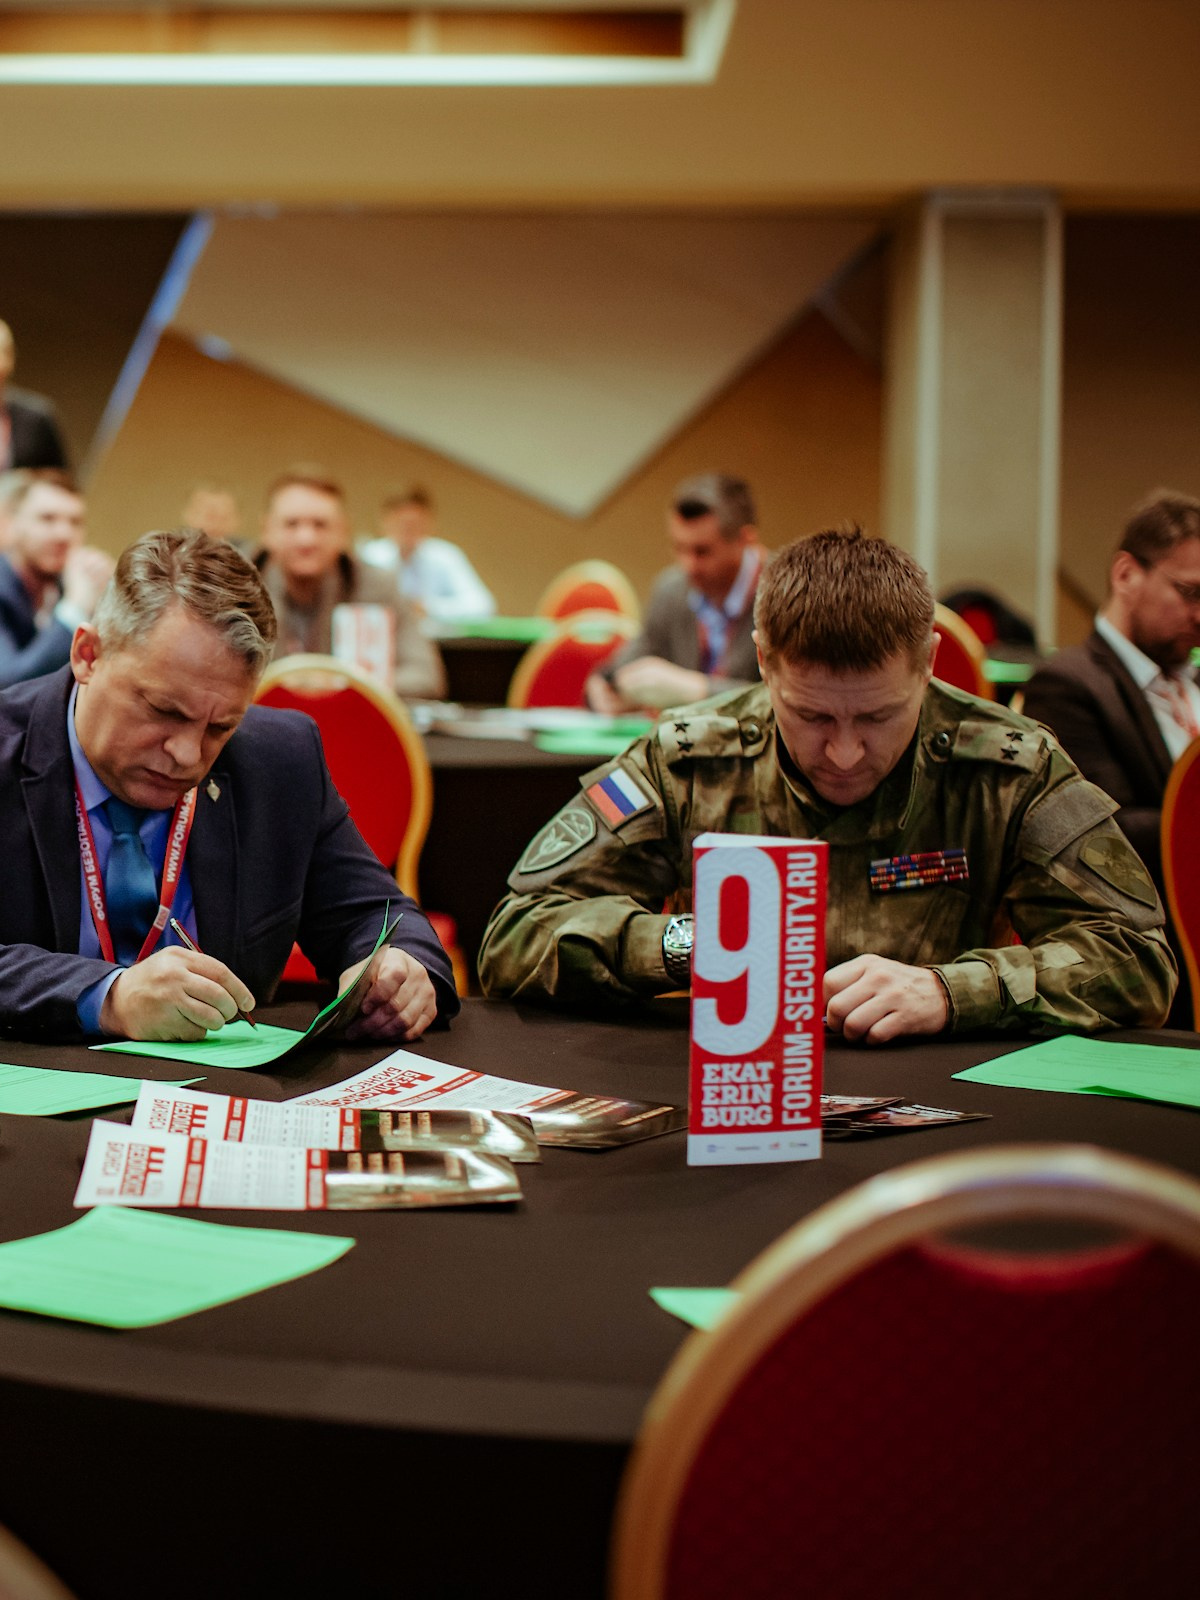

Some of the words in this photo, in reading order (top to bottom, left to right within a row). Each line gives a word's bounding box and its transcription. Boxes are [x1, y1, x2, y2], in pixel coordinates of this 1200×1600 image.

[87, 874, 105, 921] ФОРУМ
[692, 846, 782, 1057] 9
[781, 851, 817, 1126] FORUM-SECURITY.RU
[341, 1066, 402, 1093] БИЗНЕСА
[702, 1061, 775, 1084] EKAT
[701, 1083, 774, 1106] ERIN
[701, 1105, 774, 1128] BURG
